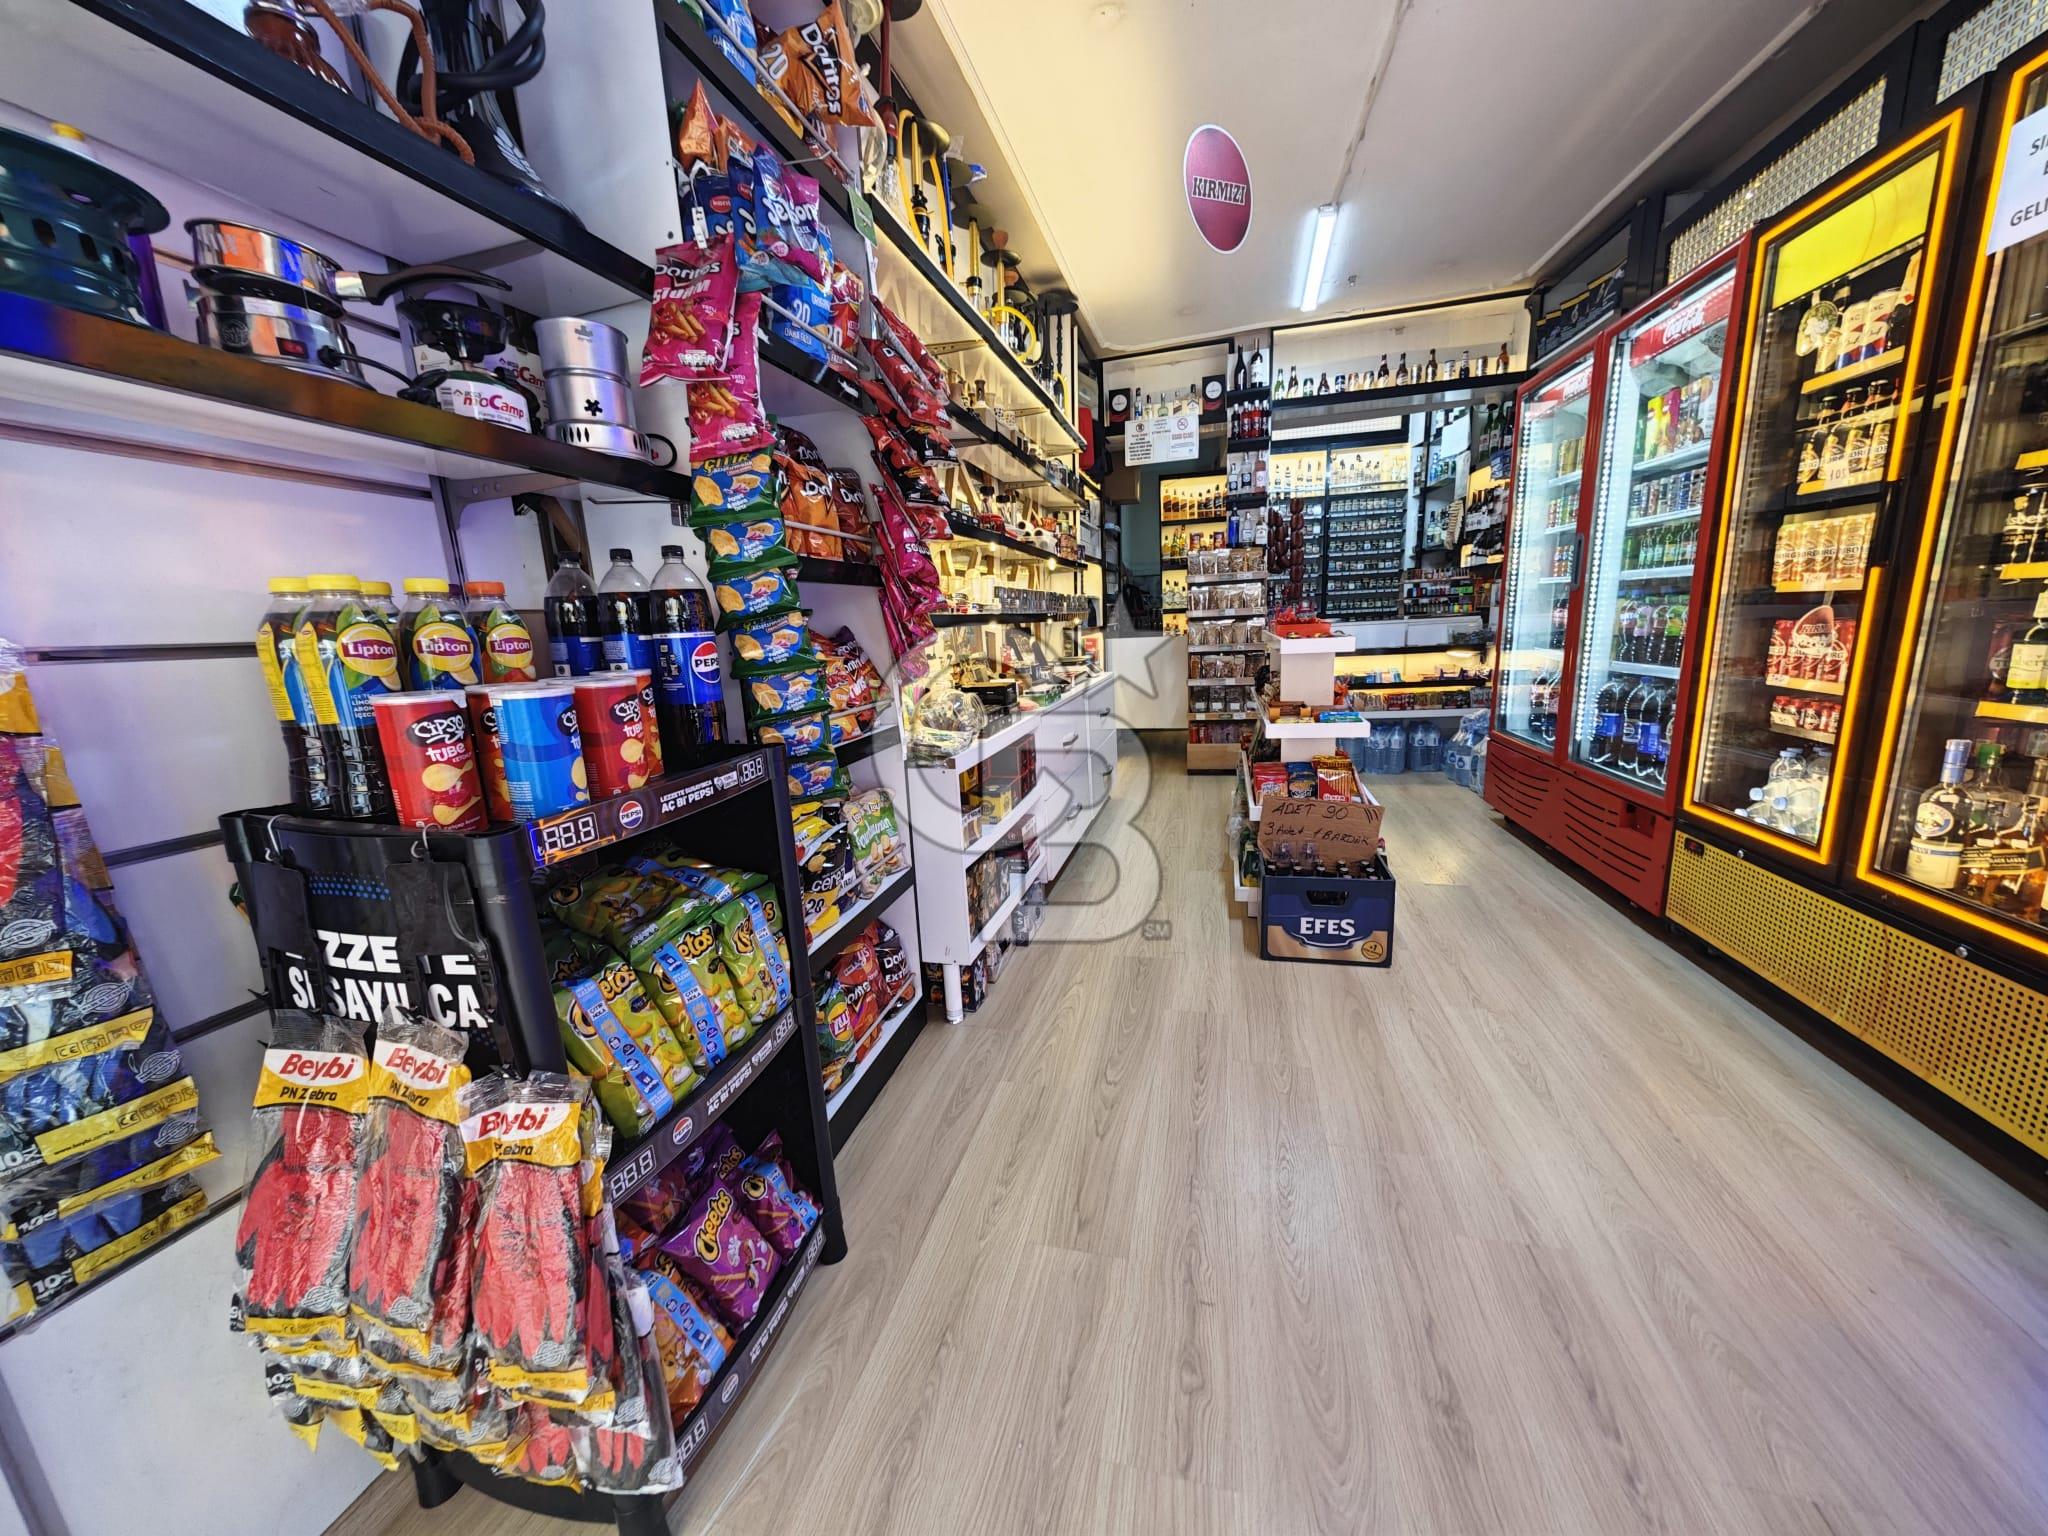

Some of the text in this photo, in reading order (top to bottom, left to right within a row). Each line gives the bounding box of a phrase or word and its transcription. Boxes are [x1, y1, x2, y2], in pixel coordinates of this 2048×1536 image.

[758, 43, 790, 80] 20
[800, 22, 843, 116] Doritos
[1192, 176, 1246, 205] KIRMIZI
[655, 262, 721, 279] Doritos
[350, 643, 394, 657] Lipton
[421, 637, 468, 653] Lipton
[493, 638, 530, 654] Lipton
[620, 808, 643, 821] PEPSI
[1272, 802, 1317, 816] ADET
[1300, 916, 1356, 937] EFES
[279, 1053, 356, 1081] Beybi
[385, 1047, 448, 1084] Beybi
[280, 1085, 297, 1099] PN
[695, 1188, 733, 1264] Cheetos
